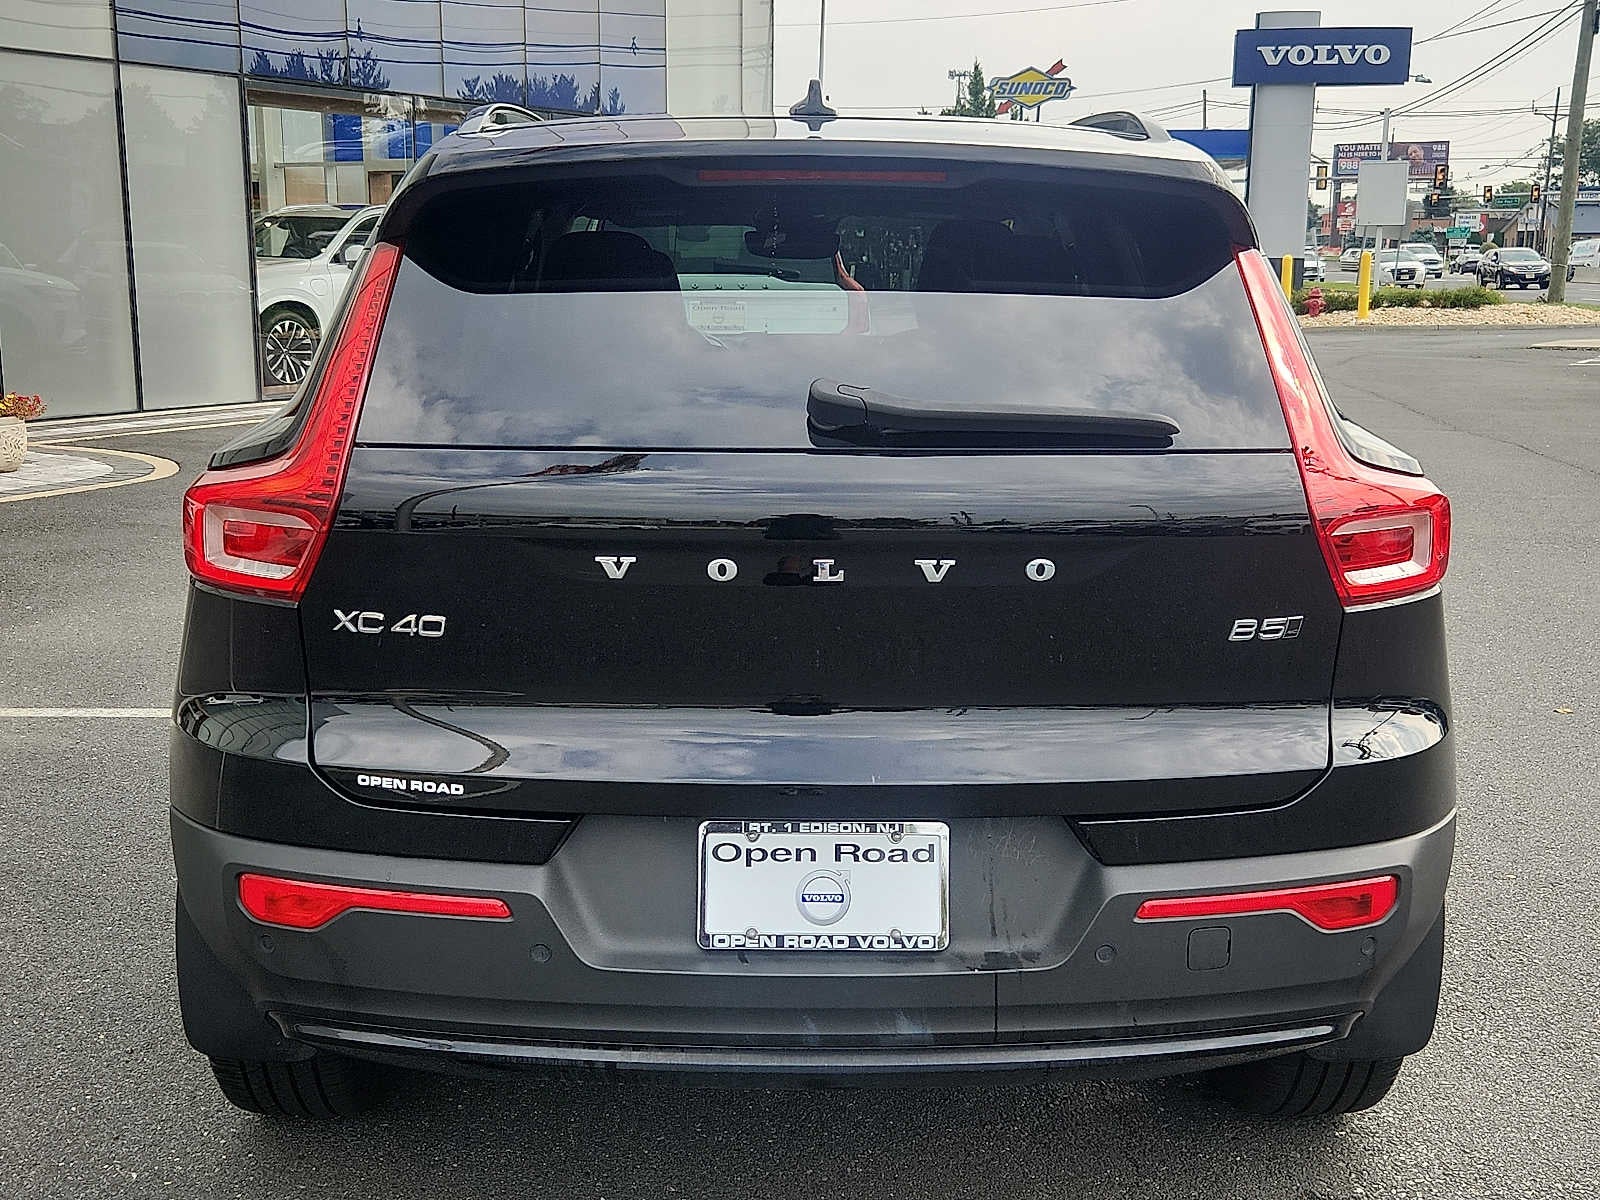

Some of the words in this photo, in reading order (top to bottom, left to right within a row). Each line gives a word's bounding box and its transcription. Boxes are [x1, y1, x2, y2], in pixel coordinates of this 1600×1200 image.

[1257, 44, 1391, 66] VOLVO
[996, 82, 1068, 95] SUNOCO
[1338, 144, 1356, 152] YOU
[1340, 161, 1359, 170] 988
[595, 556, 1056, 583] VOLVO
[333, 609, 385, 634] XC
[390, 614, 446, 638] 40
[1228, 617, 1288, 641] B5
[357, 774, 407, 790] OPEN
[410, 780, 464, 795] ROAD
[749, 823, 776, 833] RT.
[784, 823, 793, 833] 1
[876, 823, 901, 833] NJ
[712, 842, 817, 867] Open
[834, 843, 935, 863] Road
[803, 894, 843, 902] VOLVO
[713, 935, 778, 948] OPEN
[783, 935, 849, 948] ROAD
[856, 935, 935, 948] VOLVO
